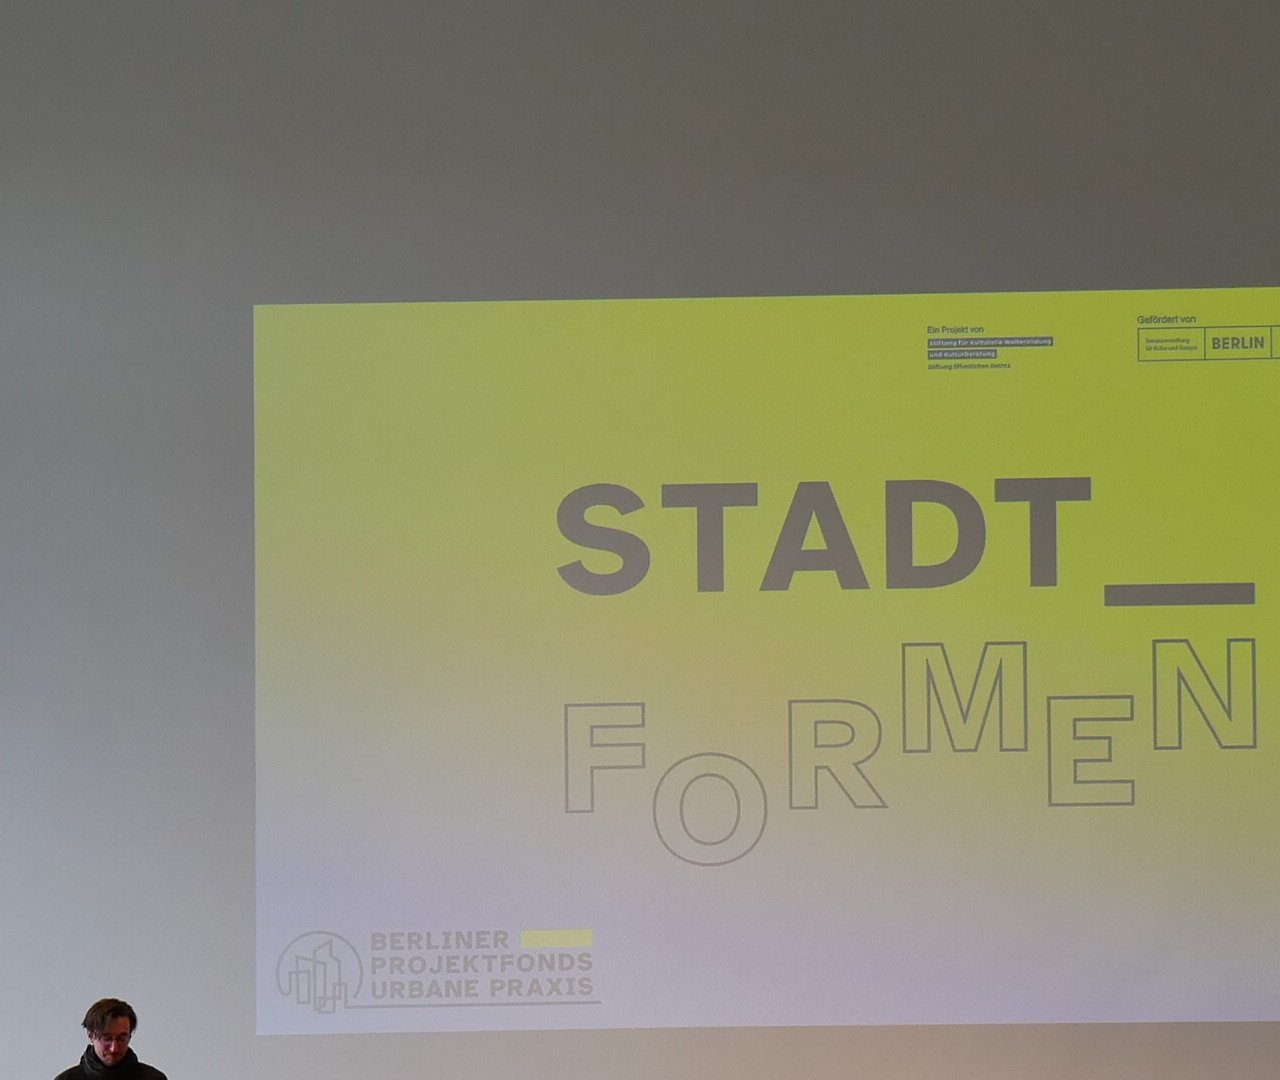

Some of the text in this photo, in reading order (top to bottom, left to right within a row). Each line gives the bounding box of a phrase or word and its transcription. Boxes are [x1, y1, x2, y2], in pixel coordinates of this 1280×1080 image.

[1137, 315, 1178, 324] Gefördert
[942, 326, 968, 335] Projekt
[1212, 336, 1265, 350] BERLIN
[564, 638, 1258, 867] FORMEN
[370, 930, 510, 951] BERLINER
[370, 953, 594, 975] PROJEKTFONDS
[370, 977, 594, 1000] URBANE PRAXIS
